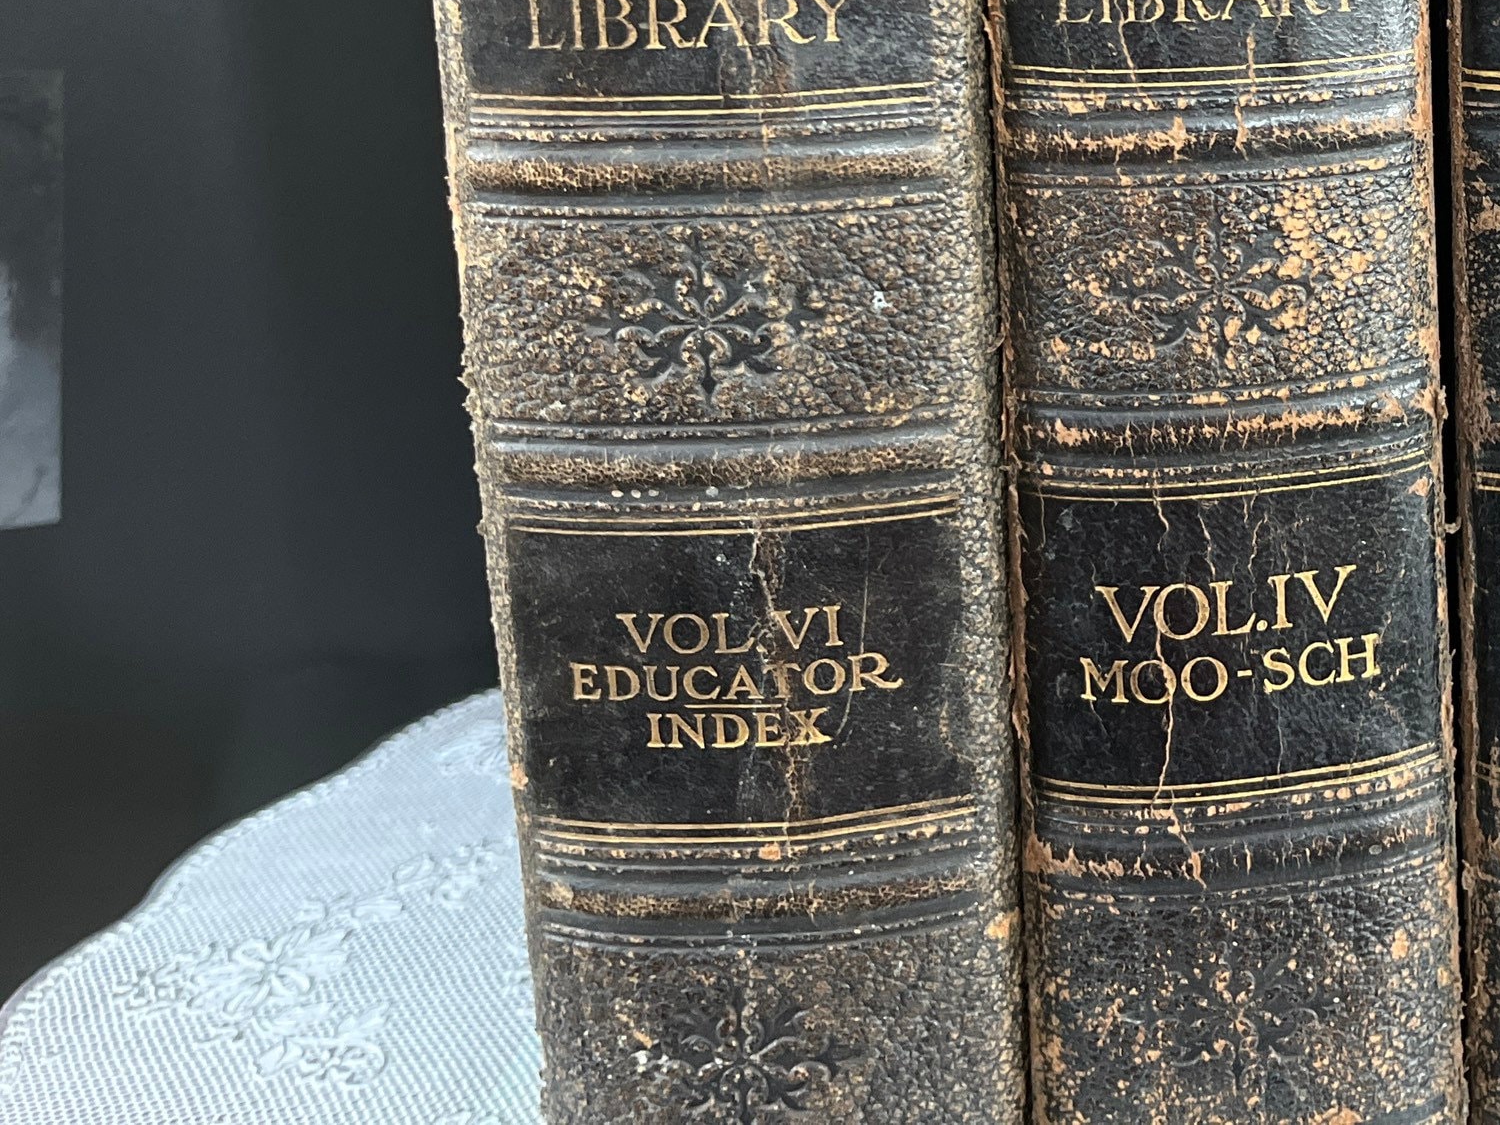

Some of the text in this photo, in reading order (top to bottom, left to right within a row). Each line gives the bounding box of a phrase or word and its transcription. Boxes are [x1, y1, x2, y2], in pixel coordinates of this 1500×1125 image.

[570, 652, 904, 701] EDUCATOR
[1080, 633, 1381, 704] MOO-SCH
[646, 707, 832, 749] INDEX
